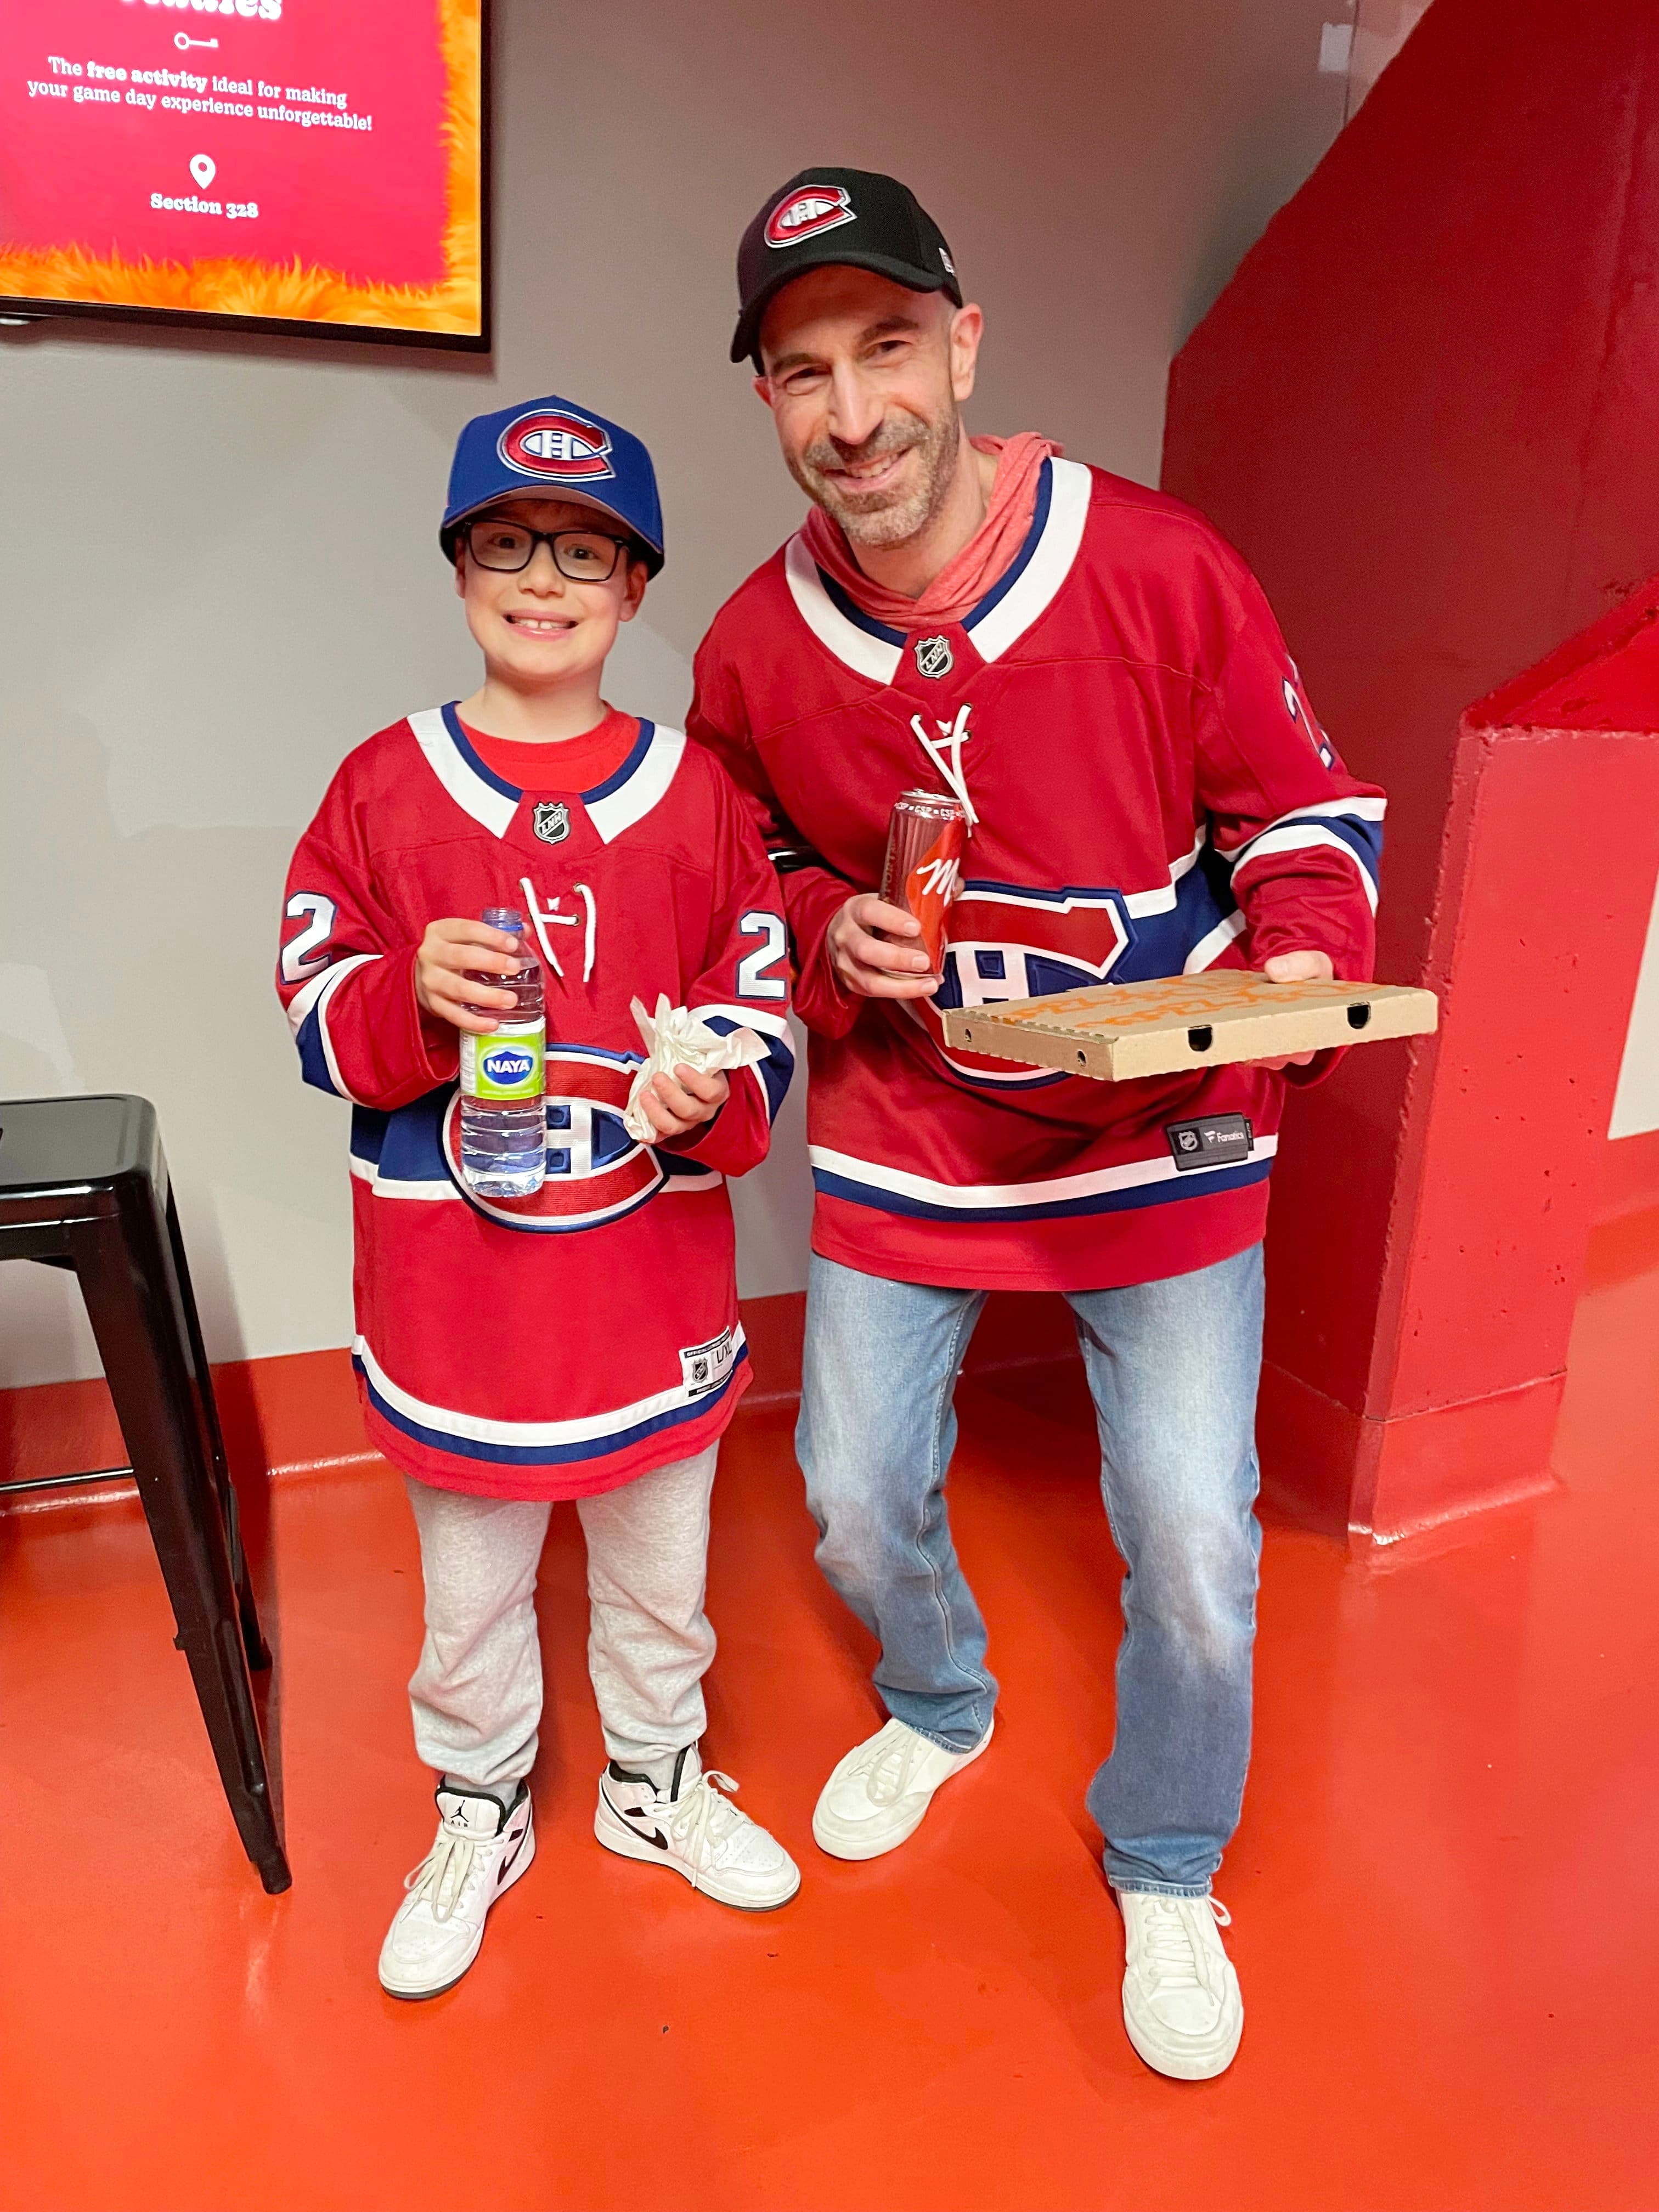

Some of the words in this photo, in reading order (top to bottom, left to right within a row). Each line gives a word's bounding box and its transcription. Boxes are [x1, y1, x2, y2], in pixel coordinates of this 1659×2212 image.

[27, 81, 68, 97] your
[73, 85, 121, 103] game
[125, 88, 156, 110] day
[161, 95, 253, 117] experience
[257, 105, 373, 131] unforgettable!
[48, 55, 82, 76] The
[87, 61, 127, 81] free
[131, 69, 208, 93] activity
[212, 76, 253, 95] ideal
[258, 81, 281, 98] for
[285, 87, 347, 110] making
[150, 193, 222, 215] Section
[225, 202, 259, 219] 328
[281, 891, 337, 985] 2
[736, 910, 787, 1000] 2
[487, 1059, 531, 1074] NAYA
